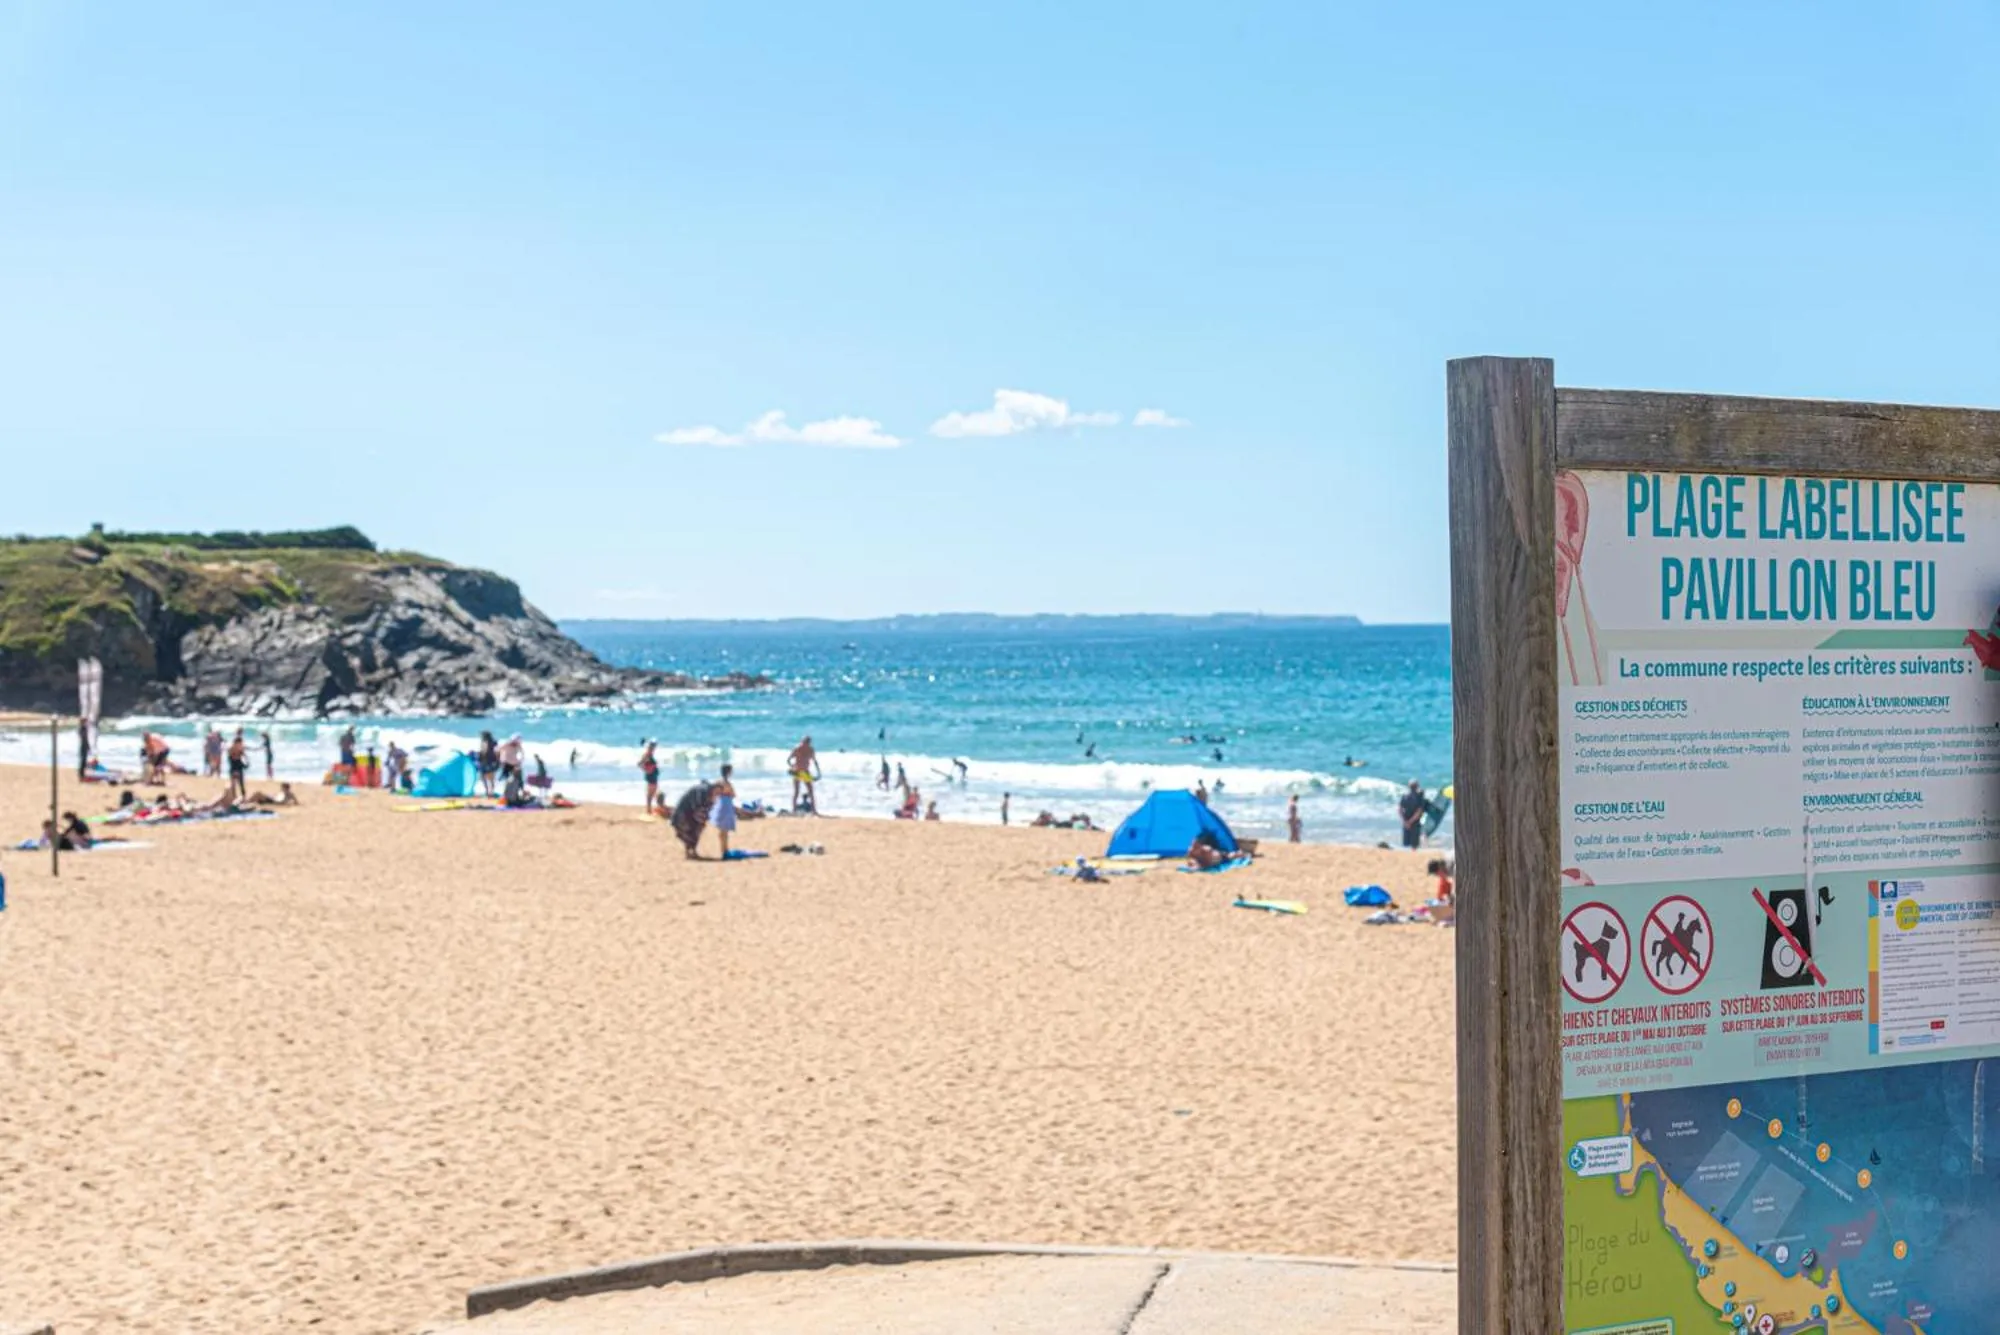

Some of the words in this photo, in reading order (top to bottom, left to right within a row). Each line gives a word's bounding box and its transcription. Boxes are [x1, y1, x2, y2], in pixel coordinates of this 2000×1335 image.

[1627, 473, 1746, 540] PLAGE
[1661, 556, 1837, 621] PAVILLON
[1849, 560, 1936, 621] BLEU
[1620, 657, 1639, 677] La
[1643, 660, 1728, 678] commune
[1733, 660, 1803, 683] respecte
[1808, 656, 1829, 675] les
[1833, 655, 1895, 675] critères
[1900, 655, 1965, 674] suivants
[1575, 701, 1619, 713] GESTION
[1621, 700, 1640, 712] DES
[1642, 697, 1688, 711] DÉCHETS
[1802, 697, 1856, 709] ÉDUCATION
[1857, 694, 1865, 707] À
[1866, 695, 1950, 707] L'ENVIRONNEMENT
[1574, 802, 1619, 815] GESTION
[1621, 802, 1634, 813] DE
[1636, 800, 1665, 813] L'EAU
[1802, 792, 1881, 807] ENVIRONNEMENT
[1883, 788, 1924, 803] GÉNÉRAL
[1563, 1011, 1594, 1030] HIENS
[1596, 1009, 1609, 1027] ET
[1611, 1005, 1658, 1025] CHEVAUX
[1660, 1000, 1711, 1021] INTERDITS
[1720, 995, 1771, 1016] SYSTÈMES
[1773, 991, 1816, 1011] SONORES
[1818, 988, 1865, 1009] INTERDITS
[1562, 1035, 1575, 1047] SUR
[1576, 1032, 1597, 1046] CETTE
[1598, 1030, 1619, 1043] PLAGE
[1621, 1030, 1630, 1042] DU
[1643, 1026, 1656, 1040] MAI
[1657, 1026, 1666, 1039] AU
[1677, 1023, 1707, 1037] OCTOBRE
[1721, 1020, 1735, 1033] SUR
[1736, 1018, 1755, 1032] CETTE
[1755, 1017, 1775, 1030] PLAGE
[1776, 1016, 1785, 1028] DU
[1568, 1223, 1620, 1266] Plage
[1628, 1216, 1651, 1246] du
[1568, 1259, 1642, 1300] Hérou
